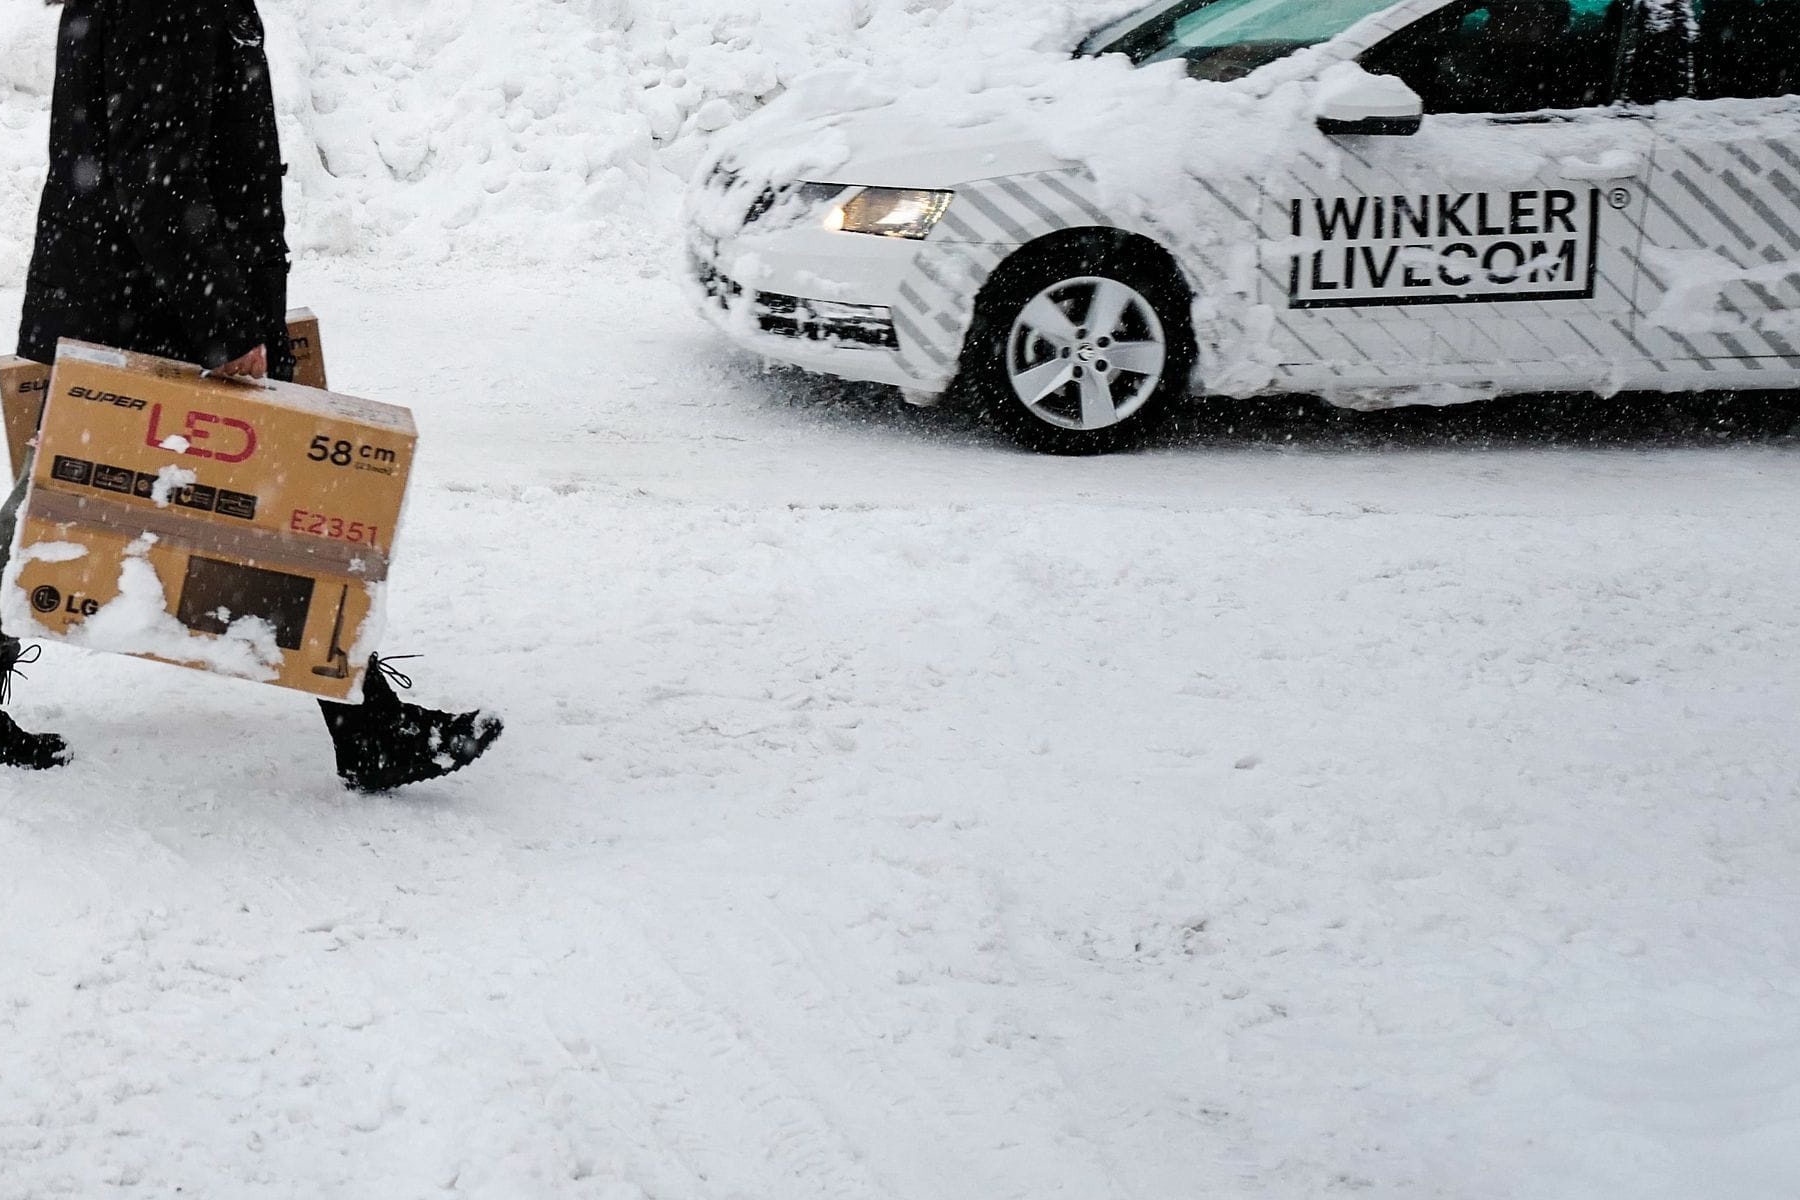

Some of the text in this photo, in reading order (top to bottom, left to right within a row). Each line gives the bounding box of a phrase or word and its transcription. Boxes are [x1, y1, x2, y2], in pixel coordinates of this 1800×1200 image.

[1314, 189, 1577, 241] WINKLER
[67, 386, 257, 463] SUPER LED
[306, 434, 396, 467] 58 cm
[289, 508, 379, 550] E2351
[64, 594, 100, 617] LG
